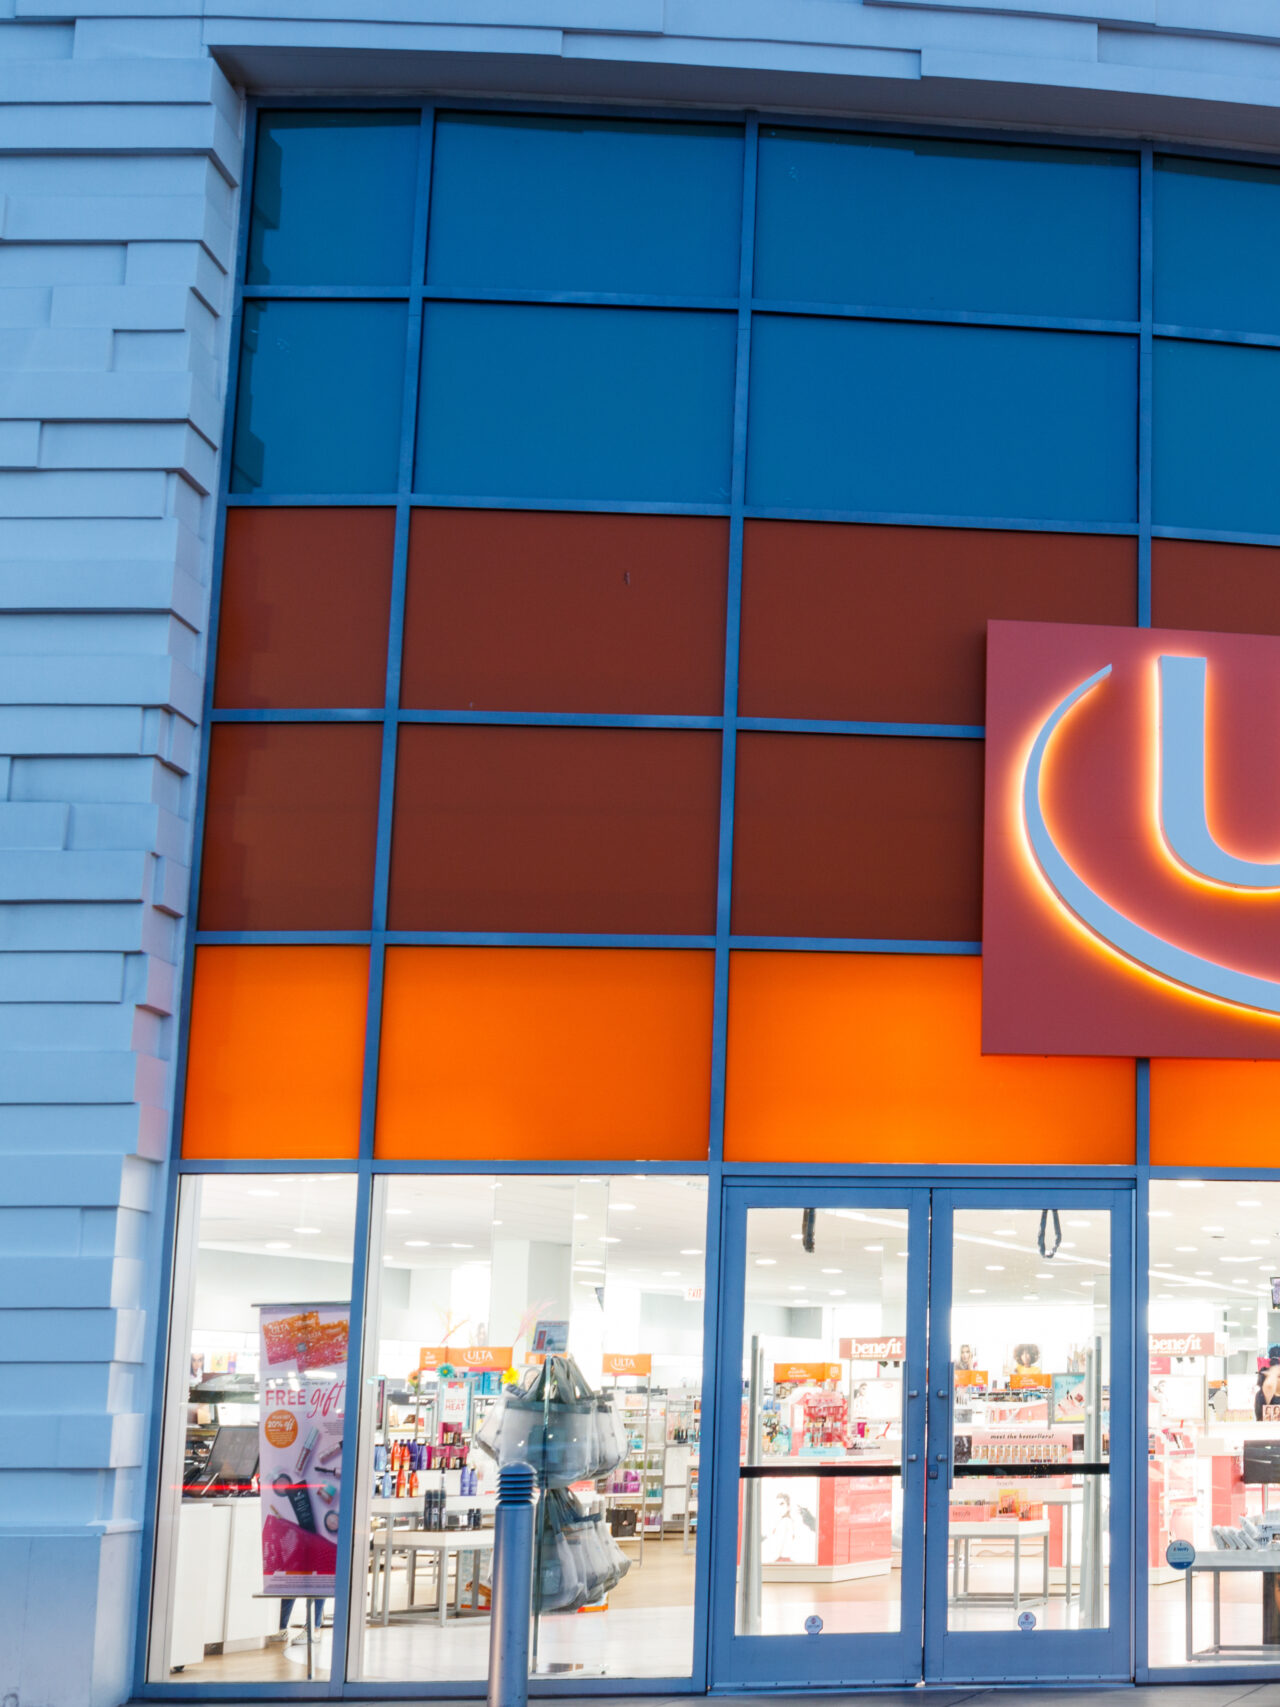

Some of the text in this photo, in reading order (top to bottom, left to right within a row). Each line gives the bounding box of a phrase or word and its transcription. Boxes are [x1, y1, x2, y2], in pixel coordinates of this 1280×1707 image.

[467, 1350, 494, 1362] ULTA
[850, 1337, 903, 1358] benefit
[614, 1356, 636, 1369] ULTA
[265, 1389, 307, 1406] FREE
[306, 1380, 347, 1419] gift
